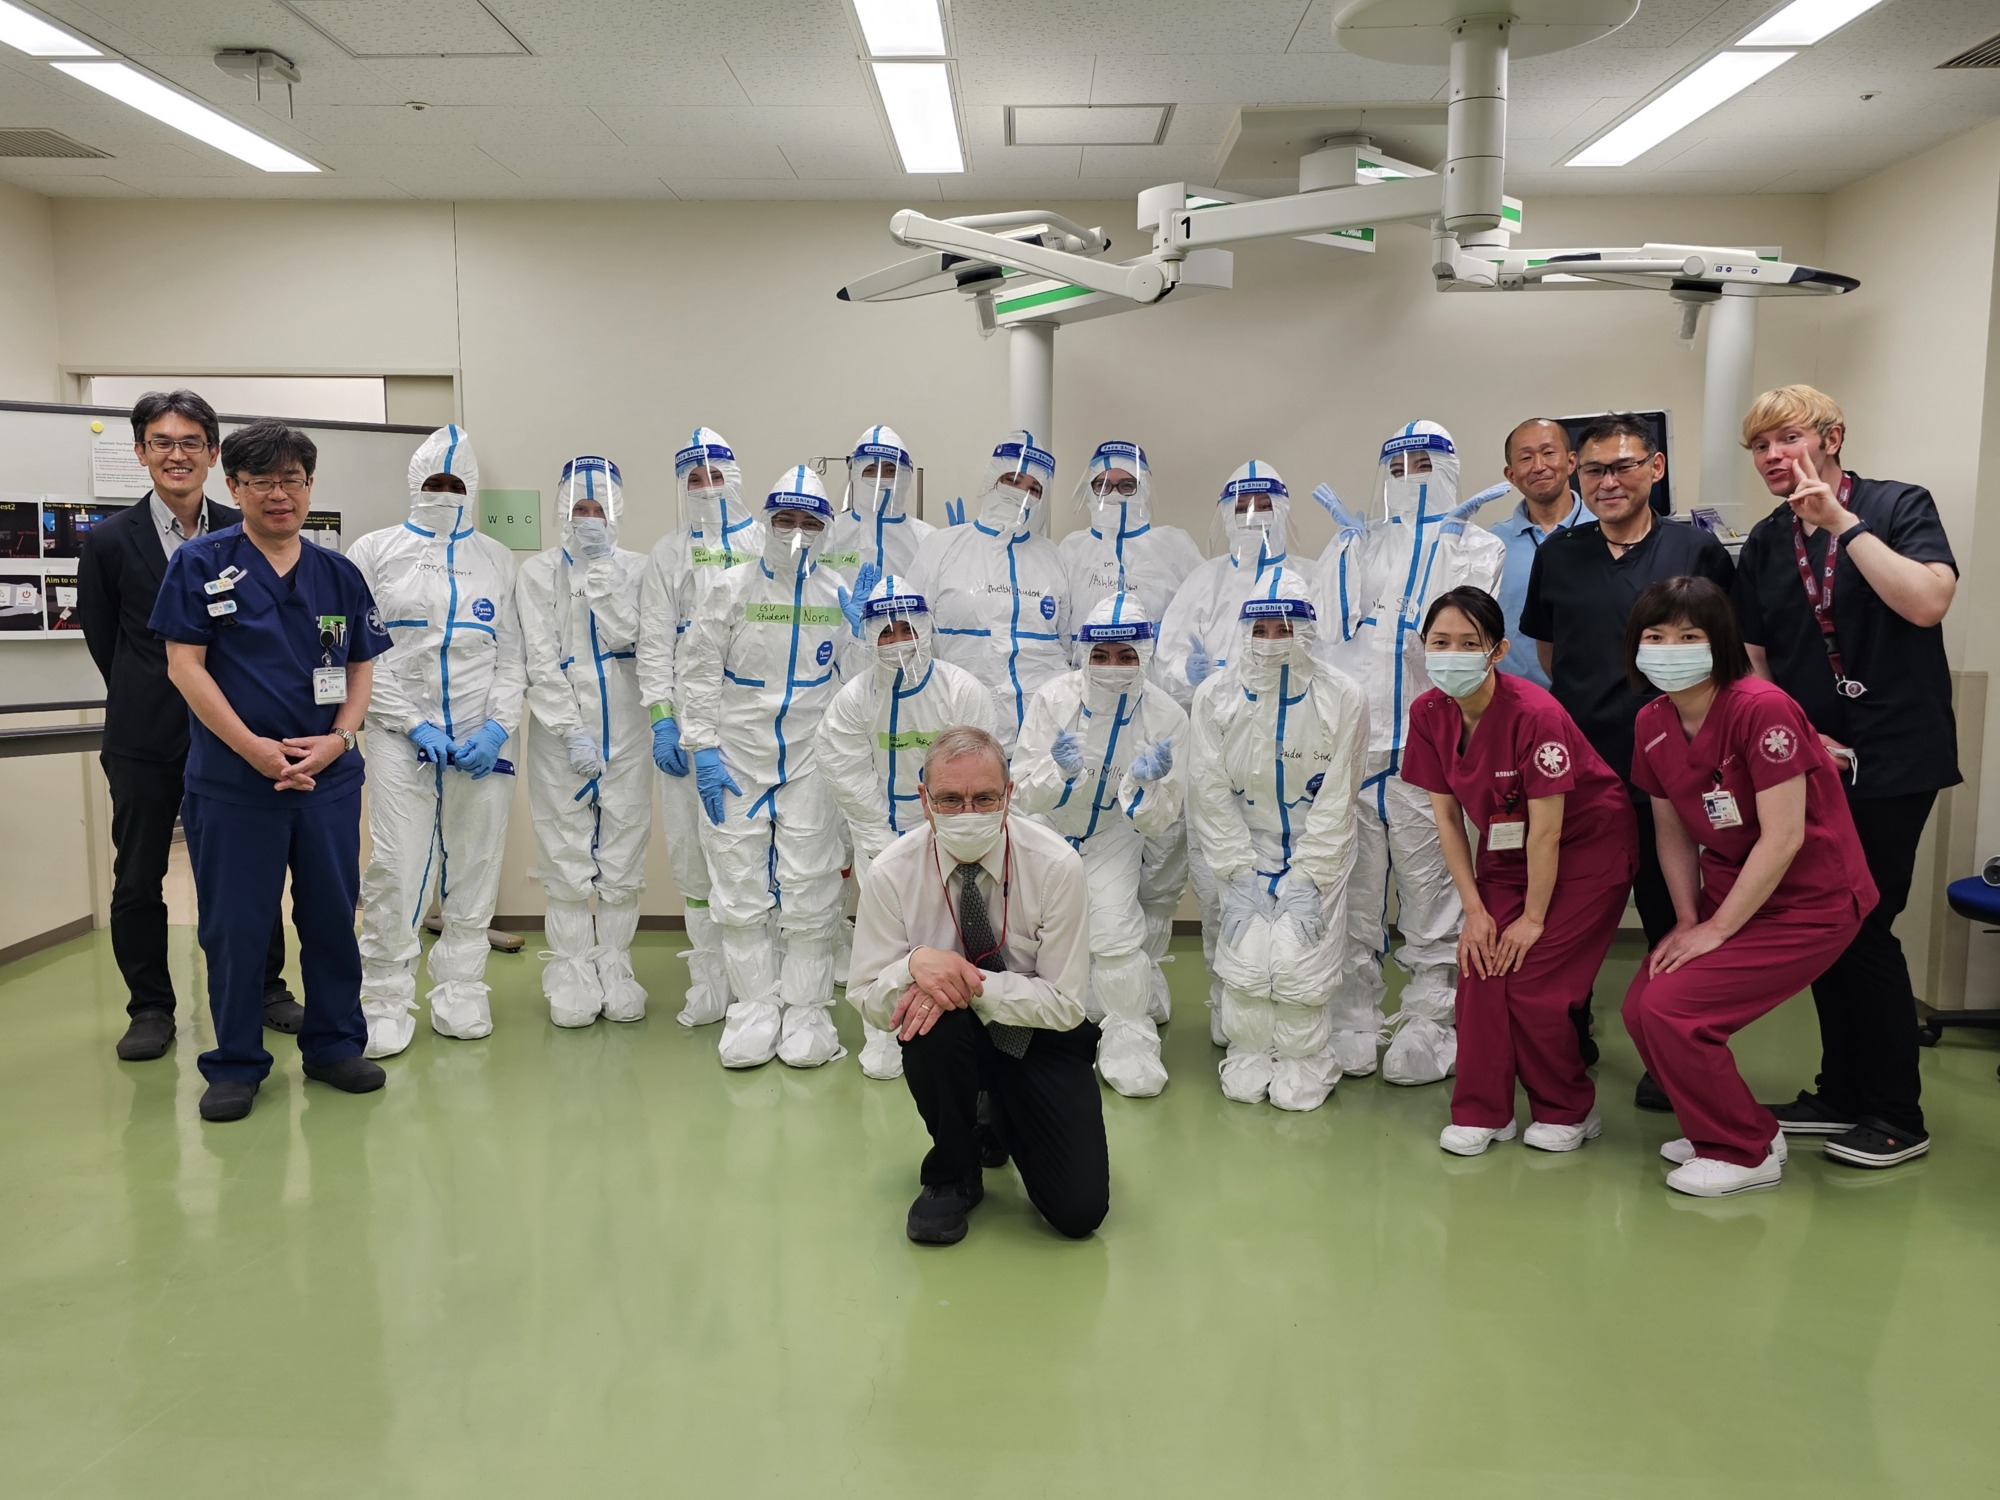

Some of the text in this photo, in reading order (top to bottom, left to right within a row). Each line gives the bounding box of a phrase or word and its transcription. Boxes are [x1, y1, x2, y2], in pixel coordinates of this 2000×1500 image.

[1181, 216, 1191, 239] 1
[795, 497, 817, 506] Shield
[46, 576, 60, 584] Aim
[894, 599, 915, 607] Sheld
[760, 604, 776, 612] CSU
[756, 613, 790, 622] Student
[803, 609, 830, 623] Nora
[1110, 628, 1134, 636] Shield
